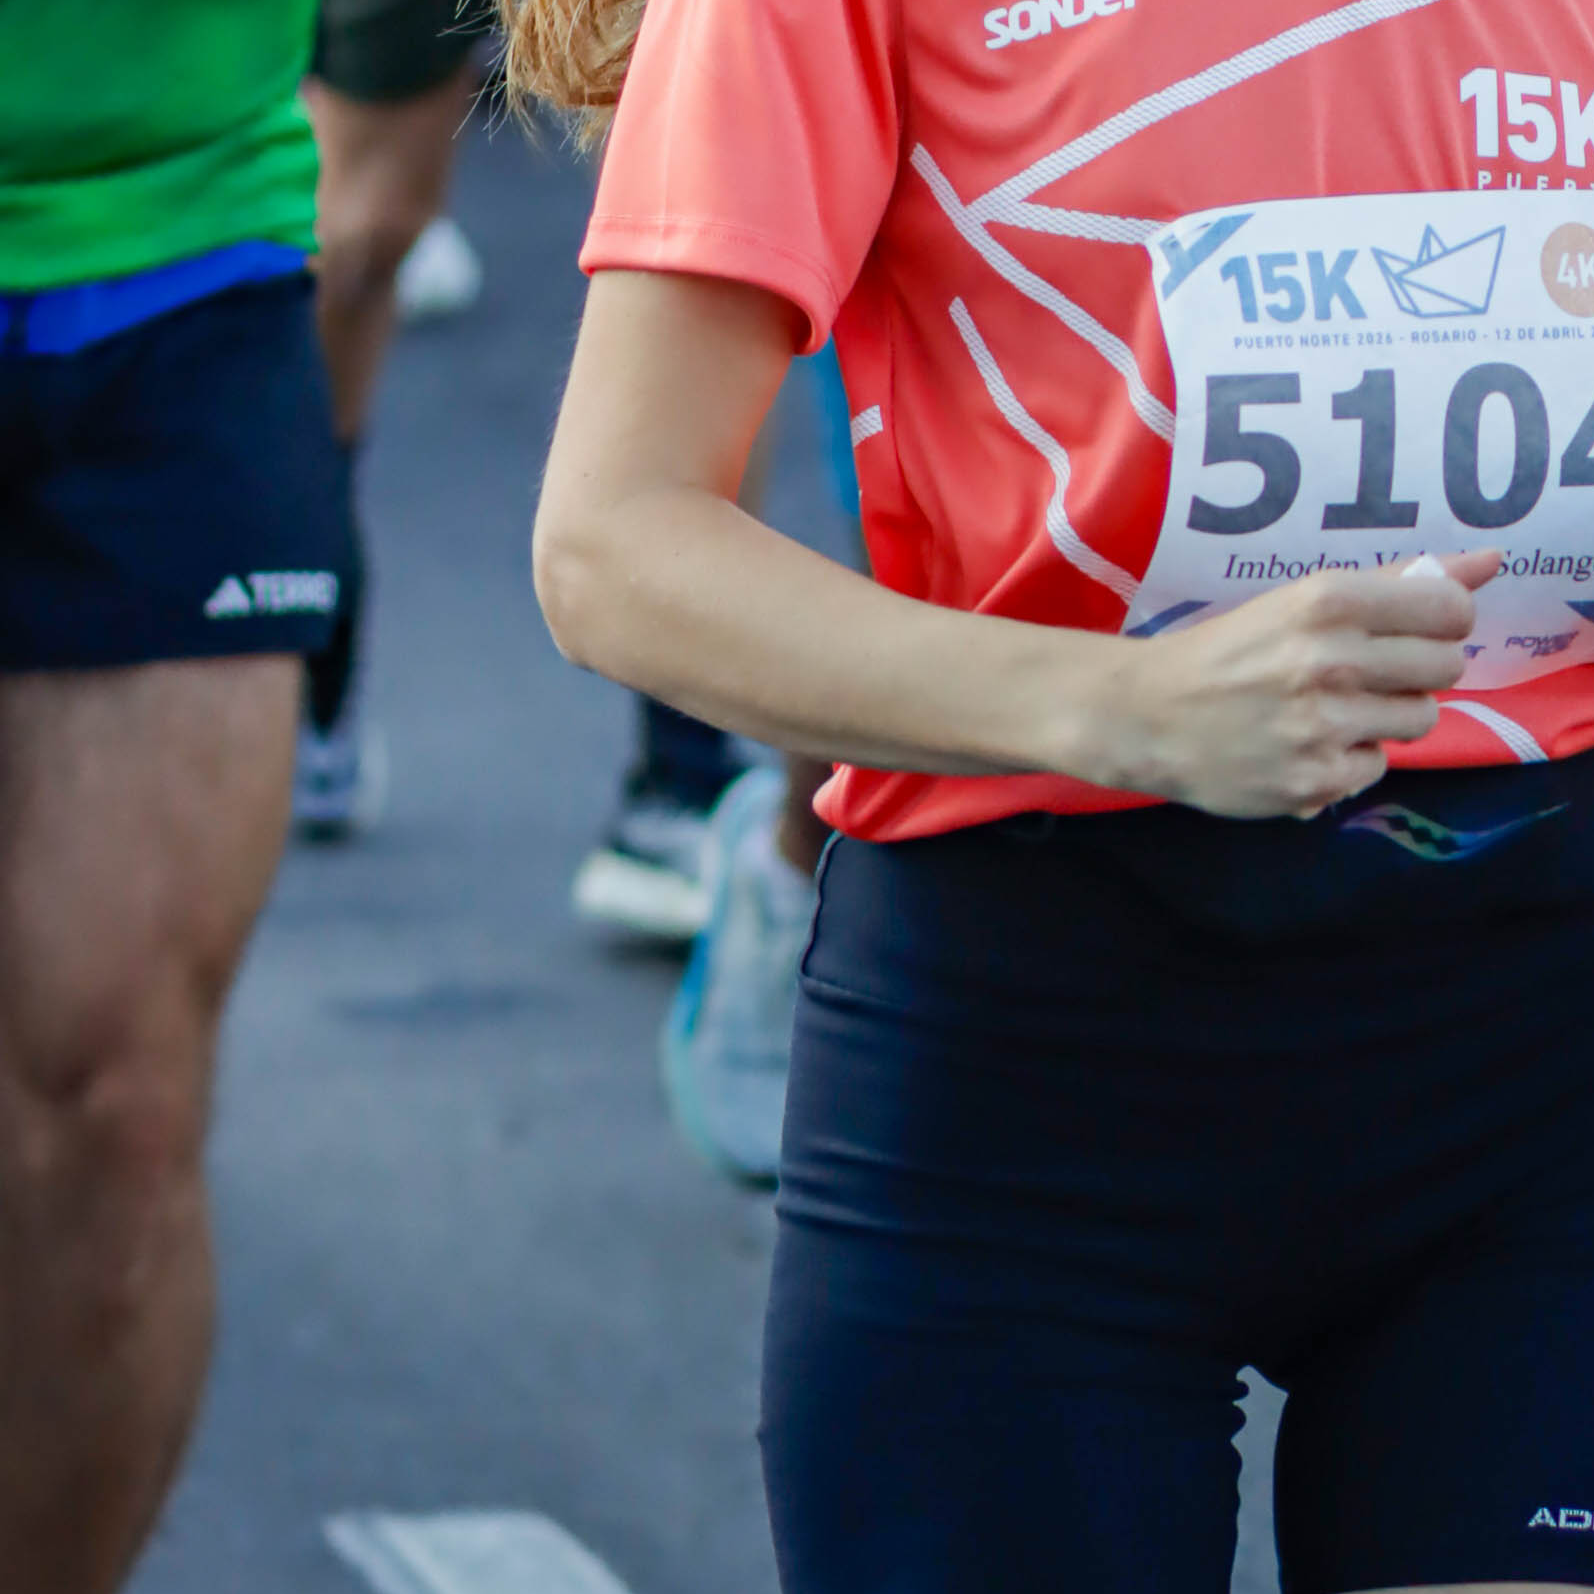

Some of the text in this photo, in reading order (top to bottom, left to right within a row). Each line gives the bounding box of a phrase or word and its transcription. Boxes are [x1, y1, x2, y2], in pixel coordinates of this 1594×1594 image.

[1219, 247, 1368, 324] 15K
[1234, 334, 1294, 350] PUERTO
[1300, 332, 1351, 348] NORTE
[1357, 331, 1393, 346] 2026
[1411, 329, 1477, 344] ROSARIO
[1495, 328, 1511, 342] 12
[1518, 327, 1536, 341] DE
[1542, 325, 1585, 340] ABRIL
